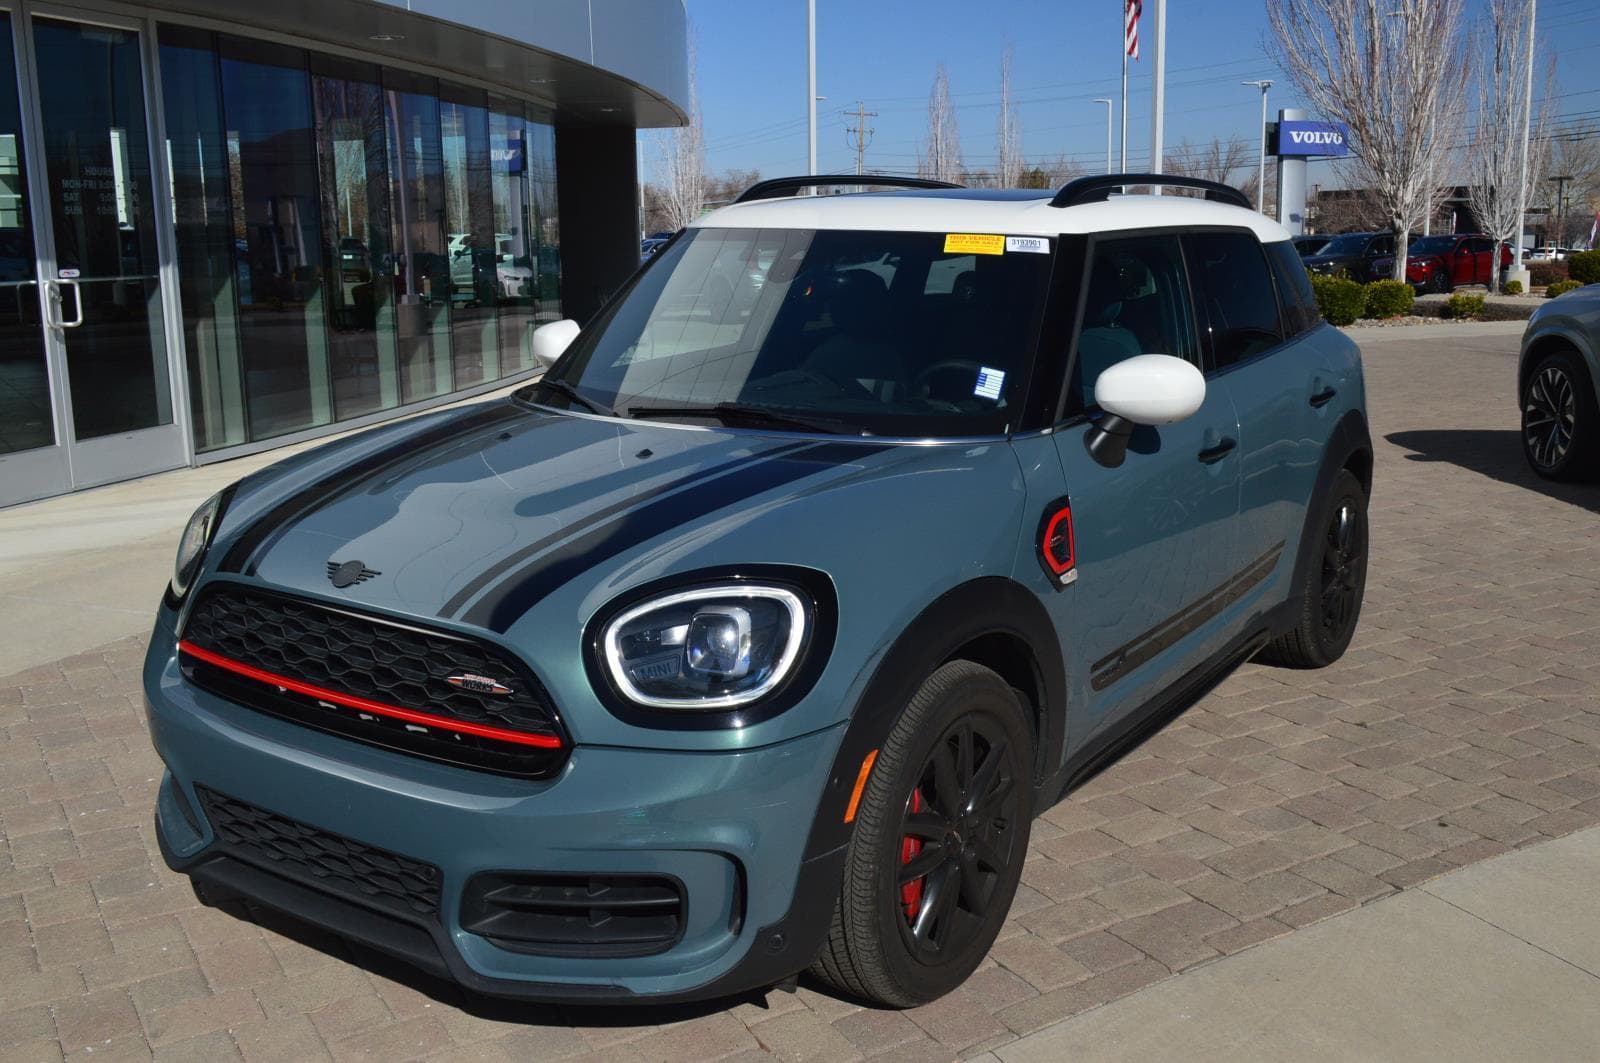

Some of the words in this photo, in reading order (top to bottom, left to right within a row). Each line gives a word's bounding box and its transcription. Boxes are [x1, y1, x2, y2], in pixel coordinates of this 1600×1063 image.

[1290, 131, 1343, 145] VOLVO
[641, 662, 672, 679] MINI
[463, 679, 494, 693] WORKS
